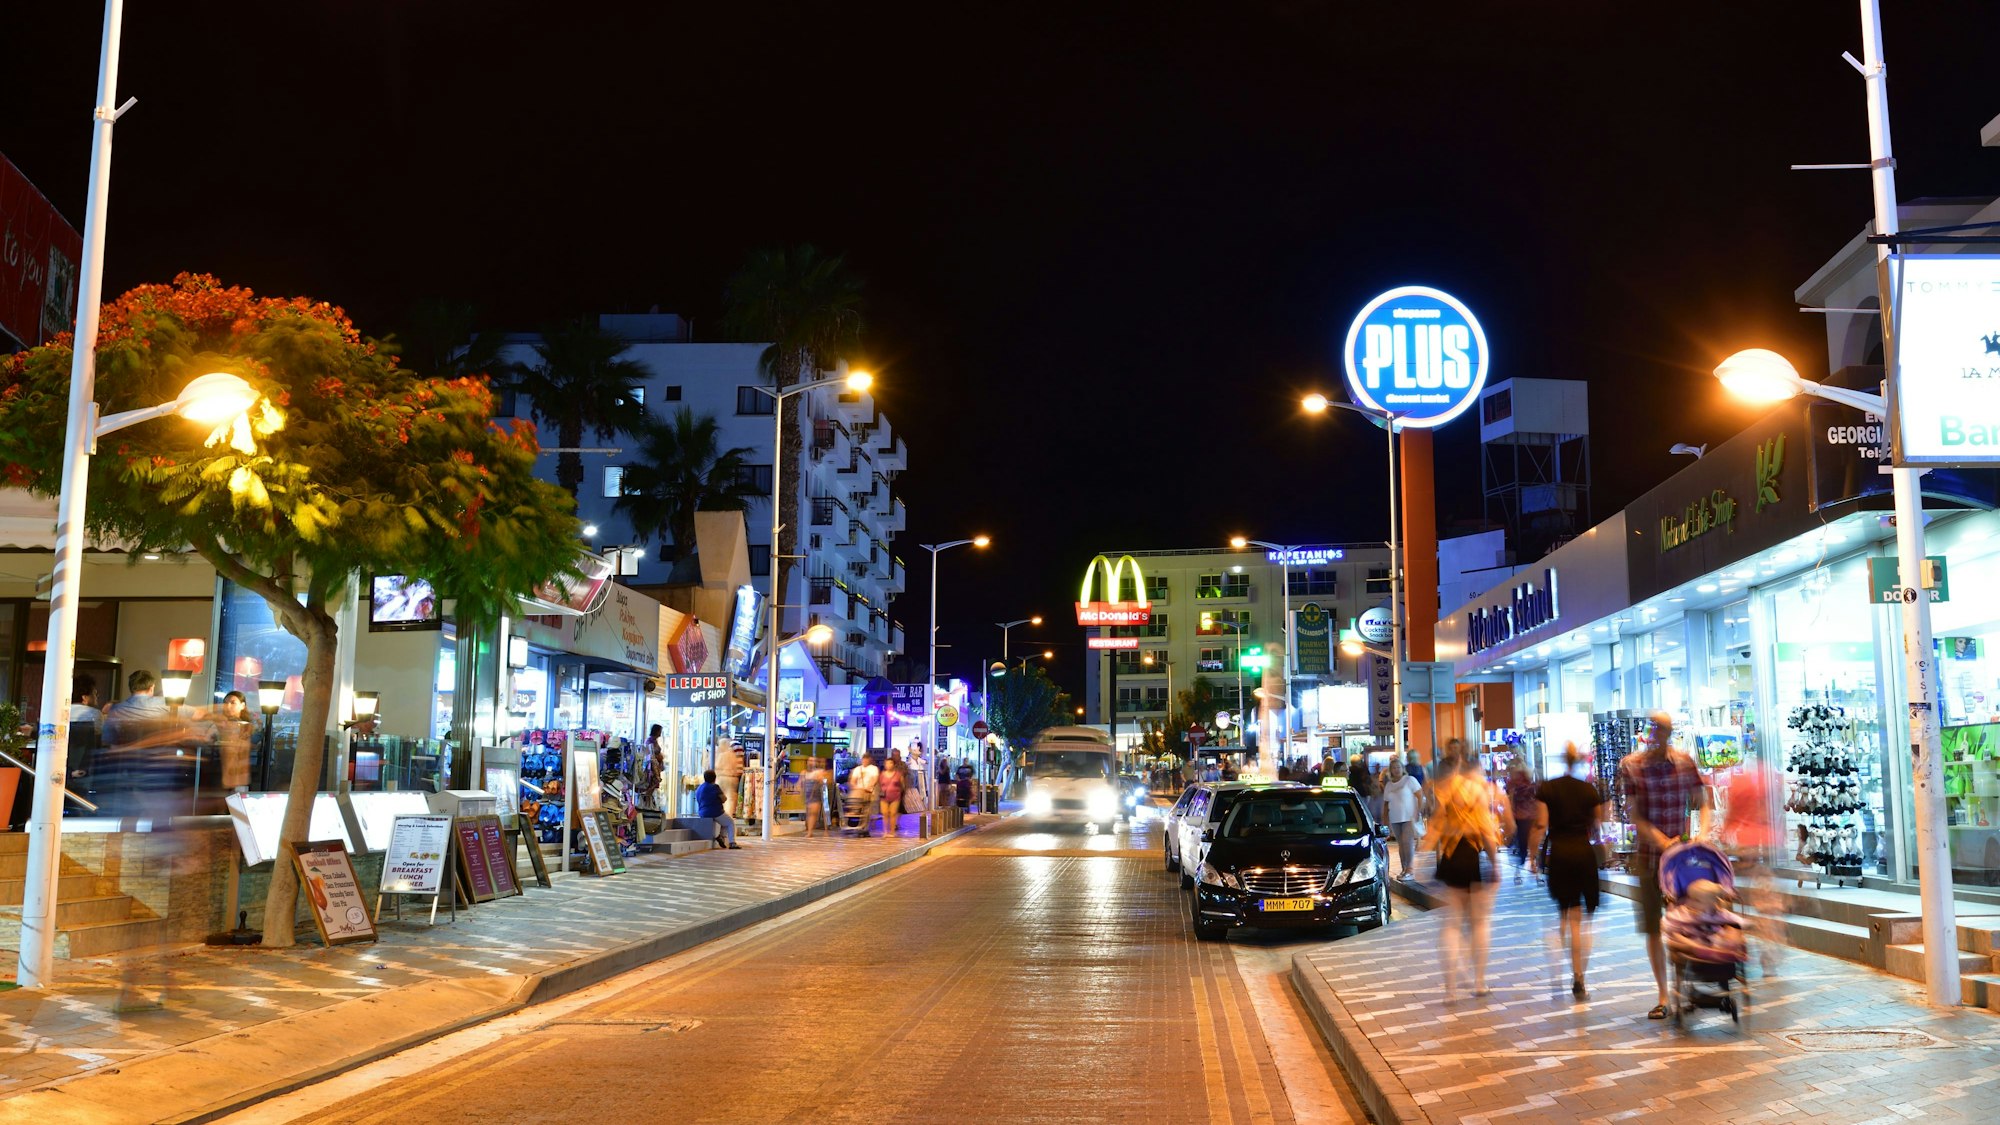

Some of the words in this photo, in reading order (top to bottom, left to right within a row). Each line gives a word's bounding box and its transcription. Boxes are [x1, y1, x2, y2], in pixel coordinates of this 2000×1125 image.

[20, 250, 43, 292] you
[1906, 281, 1984, 294] TOMMY
[1363, 324, 1470, 389] PLUS
[1711, 489, 1734, 535] Shop
[1080, 612, 1149, 620] McDonald's
[1467, 604, 1513, 655] Atlantis
[1512, 568, 1559, 635] Island
[1089, 639, 1138, 647] RESTAURANT
[670, 677, 727, 689] LEPUS
[690, 690, 706, 703] GIFT
[707, 689, 726, 700] SHOP
[909, 686, 923, 698] BAR
[897, 703, 911, 712] BAR
[1266, 900, 1285, 910] MMM
[1292, 899, 1311, 909] 707
